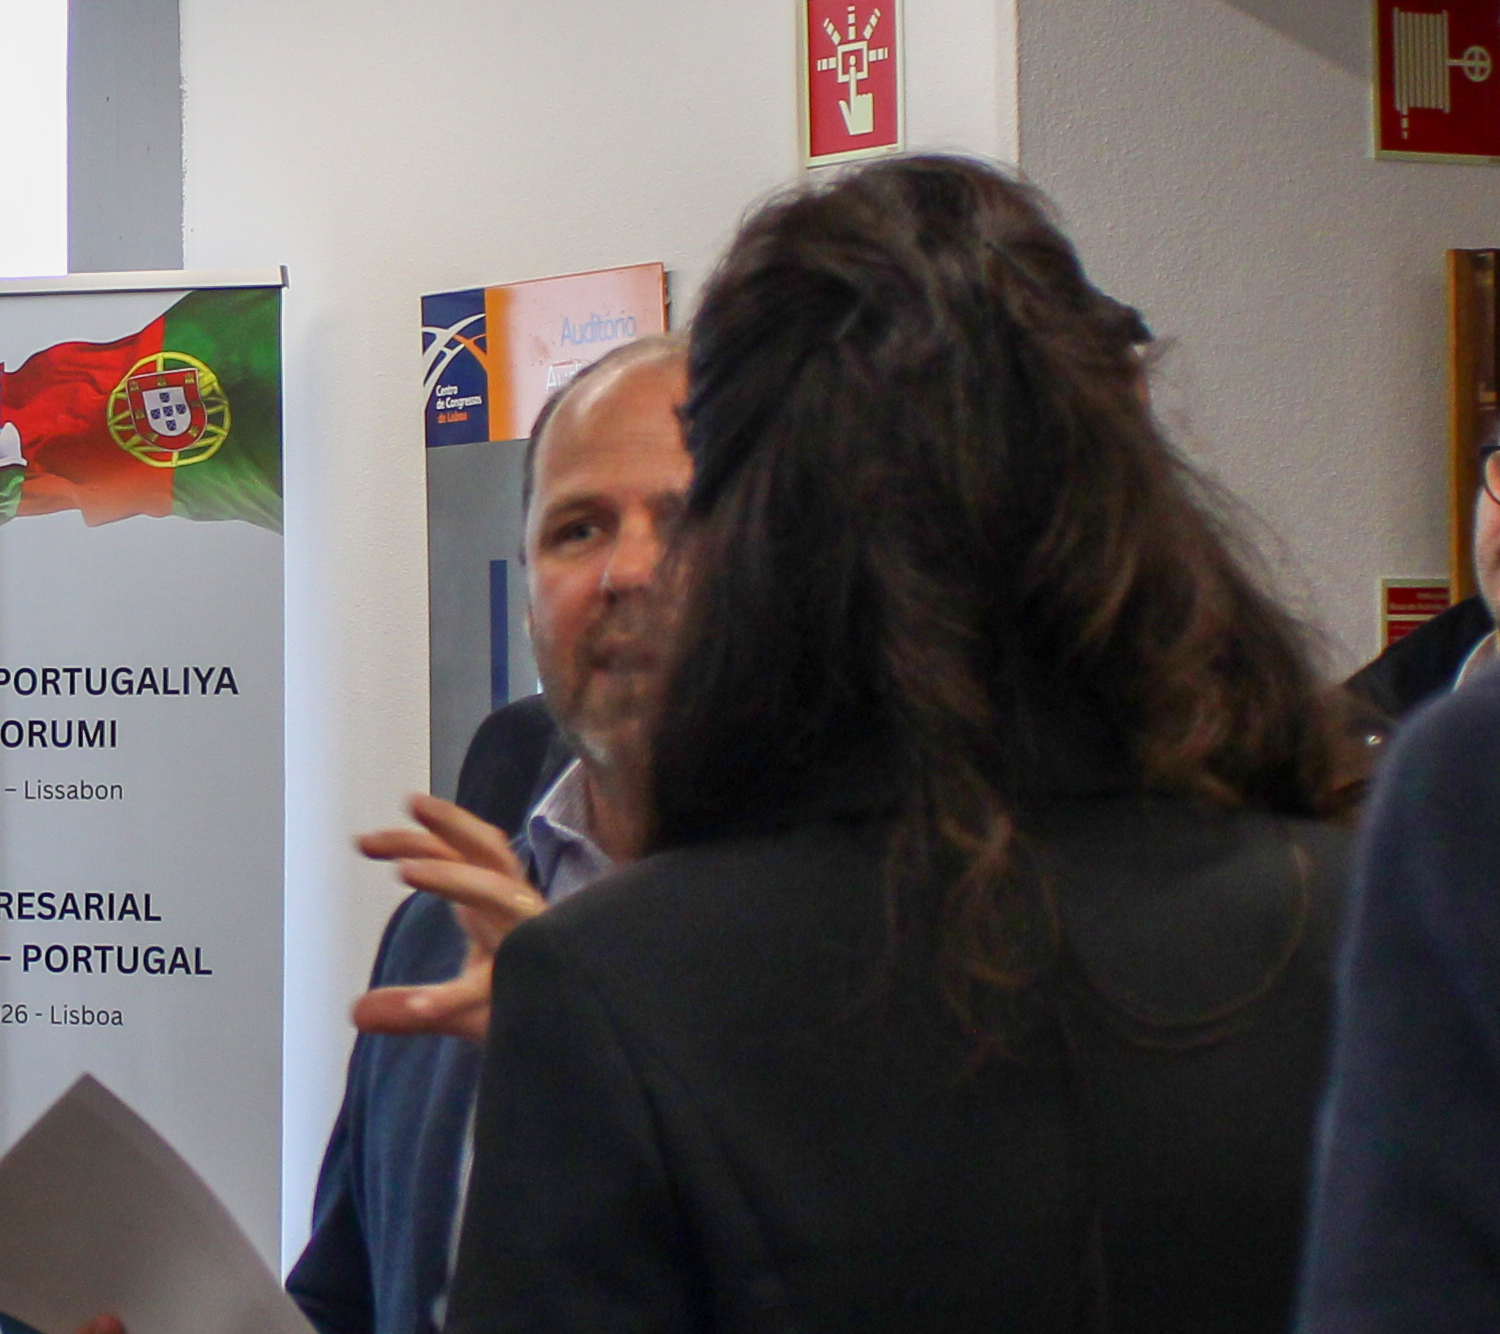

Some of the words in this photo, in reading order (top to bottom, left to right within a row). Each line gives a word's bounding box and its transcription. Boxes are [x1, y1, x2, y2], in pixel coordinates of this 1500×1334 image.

[24, 778, 124, 801] Lissabon
[22, 944, 213, 977] PORTUGAL
[50, 1004, 124, 1027] Lisboa
